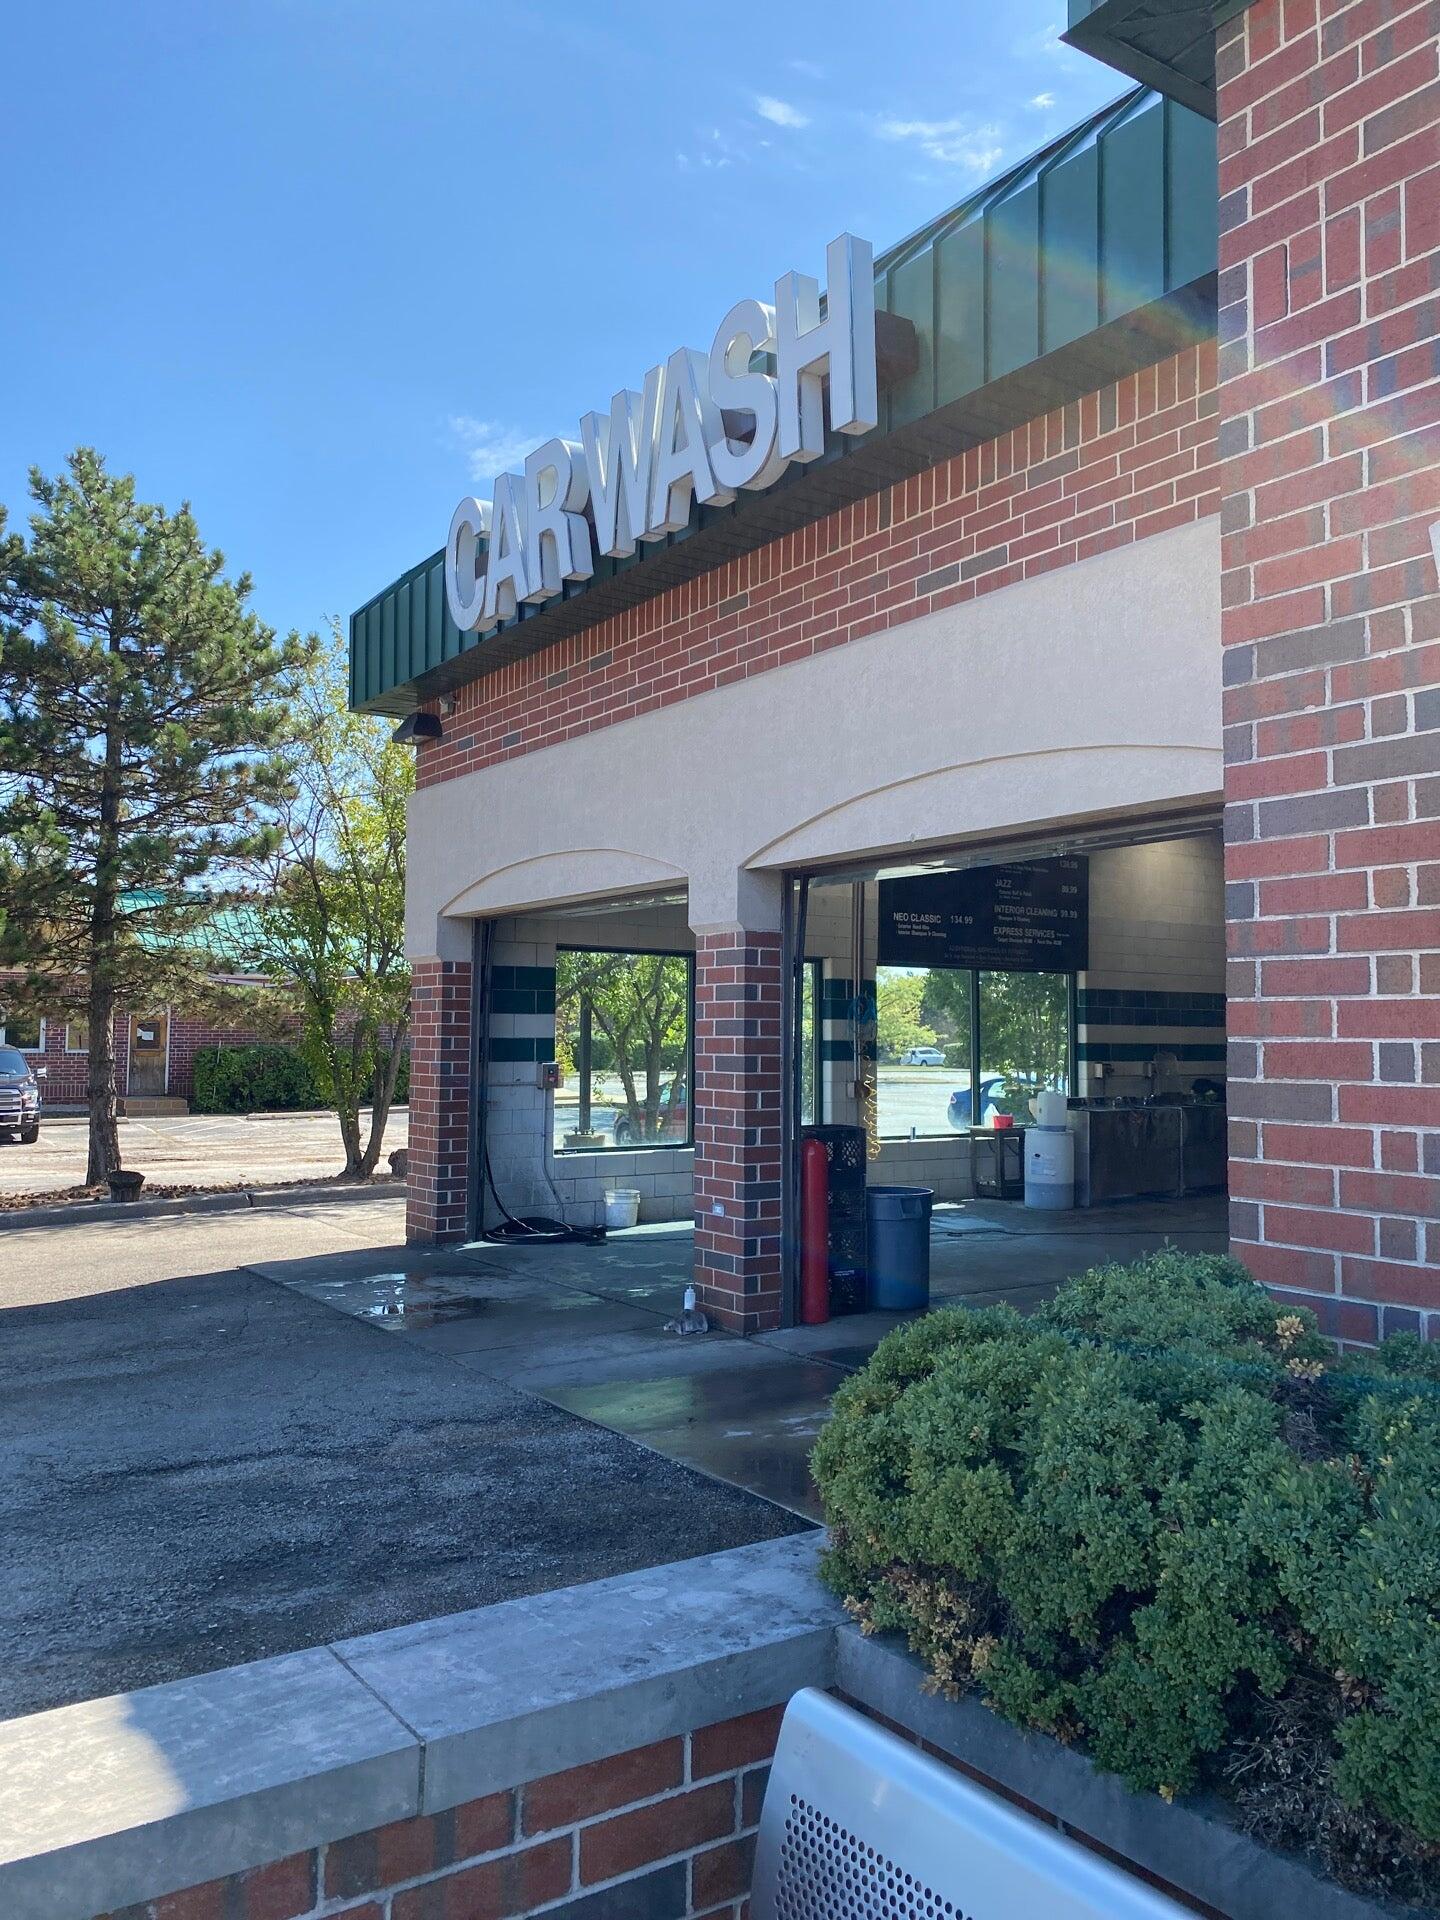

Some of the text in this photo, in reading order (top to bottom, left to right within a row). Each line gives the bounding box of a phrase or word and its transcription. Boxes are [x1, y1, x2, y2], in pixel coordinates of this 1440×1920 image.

[995, 879, 1012, 888] JAZZ
[994, 905, 1024, 915] INTERIOR
[1025, 907, 1058, 918] CLEANING
[893, 912, 973, 925] NEO CLASSIC 134.99
[993, 926, 1024, 937] EXPRESS
[1024, 928, 1055, 938] SERVICES
